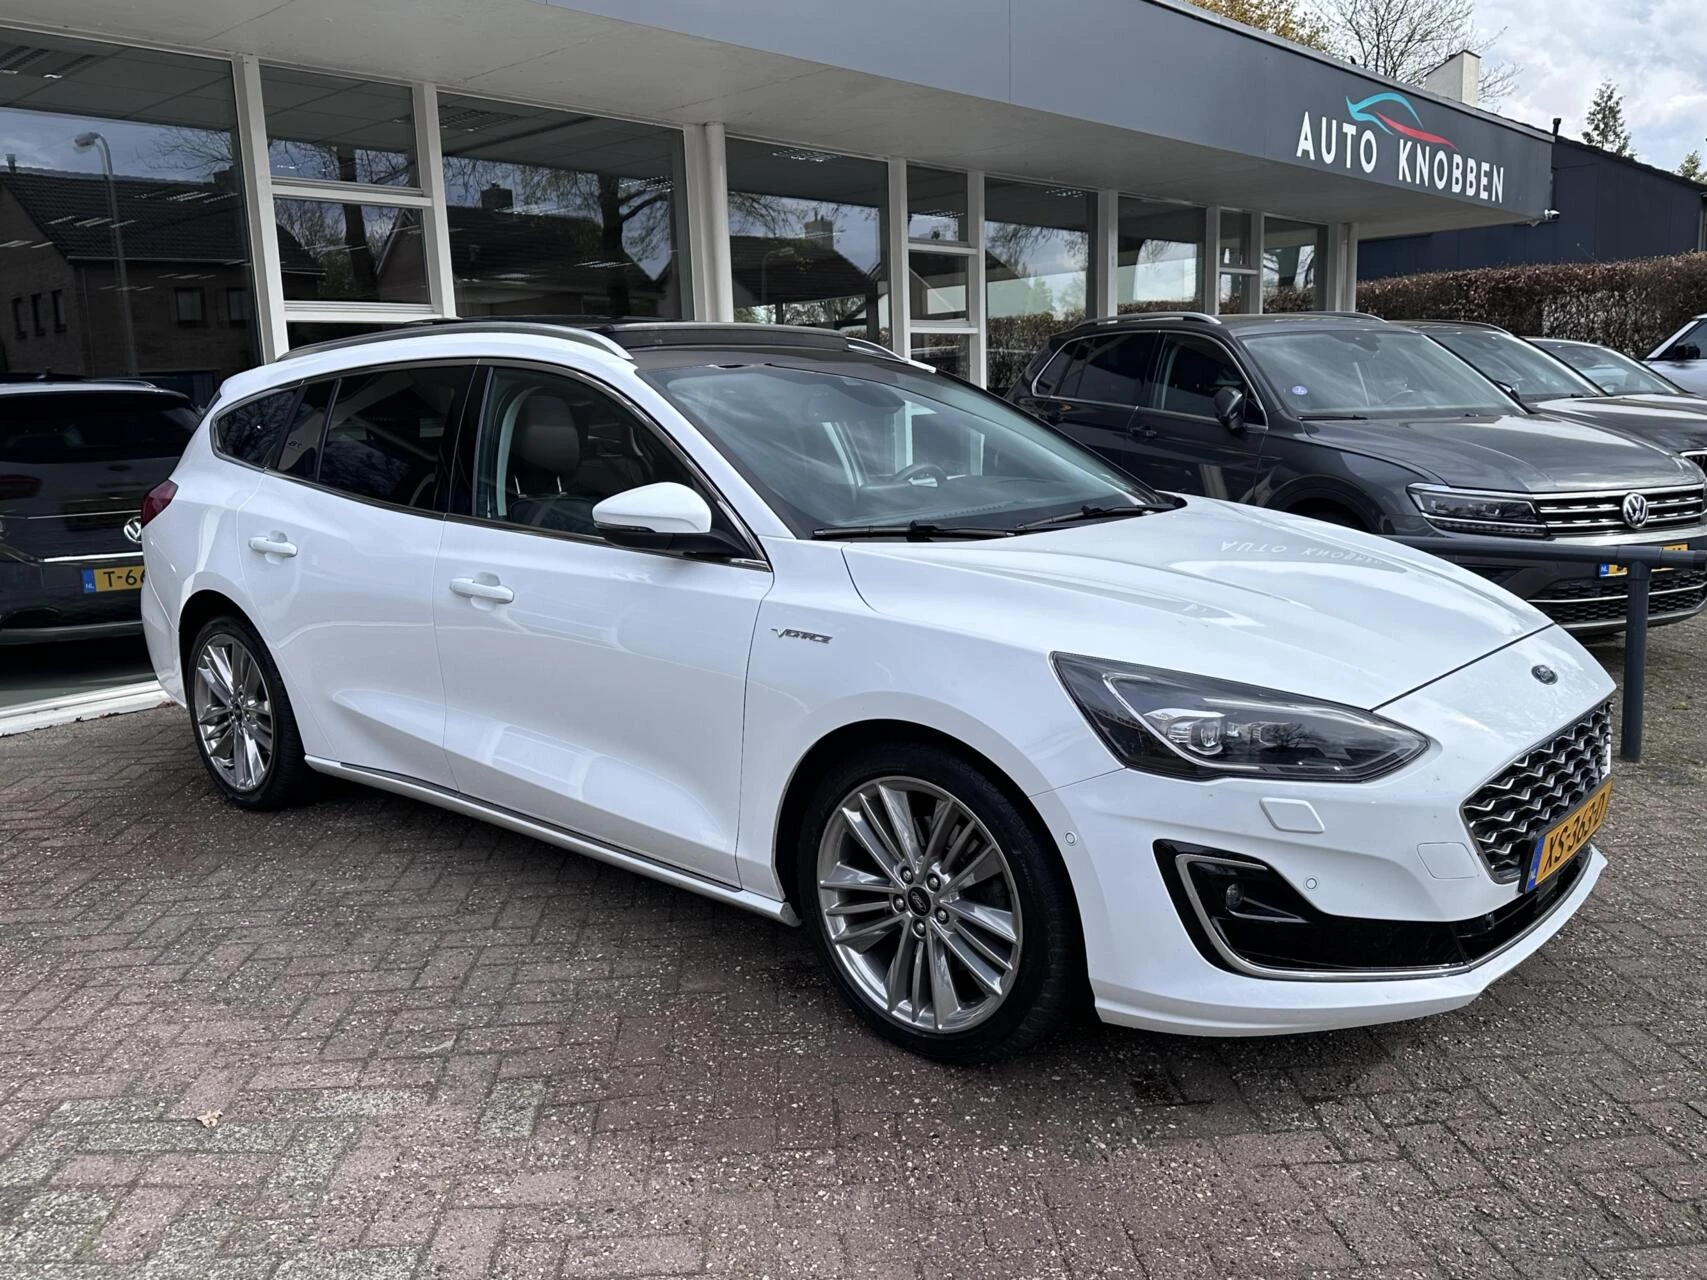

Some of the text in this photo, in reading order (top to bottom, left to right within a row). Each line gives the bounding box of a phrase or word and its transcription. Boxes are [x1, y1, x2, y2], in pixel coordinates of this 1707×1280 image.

[1296, 111, 1505, 203] AUTO KNOBBEN
[1543, 792, 1606, 873] XS-363-D
